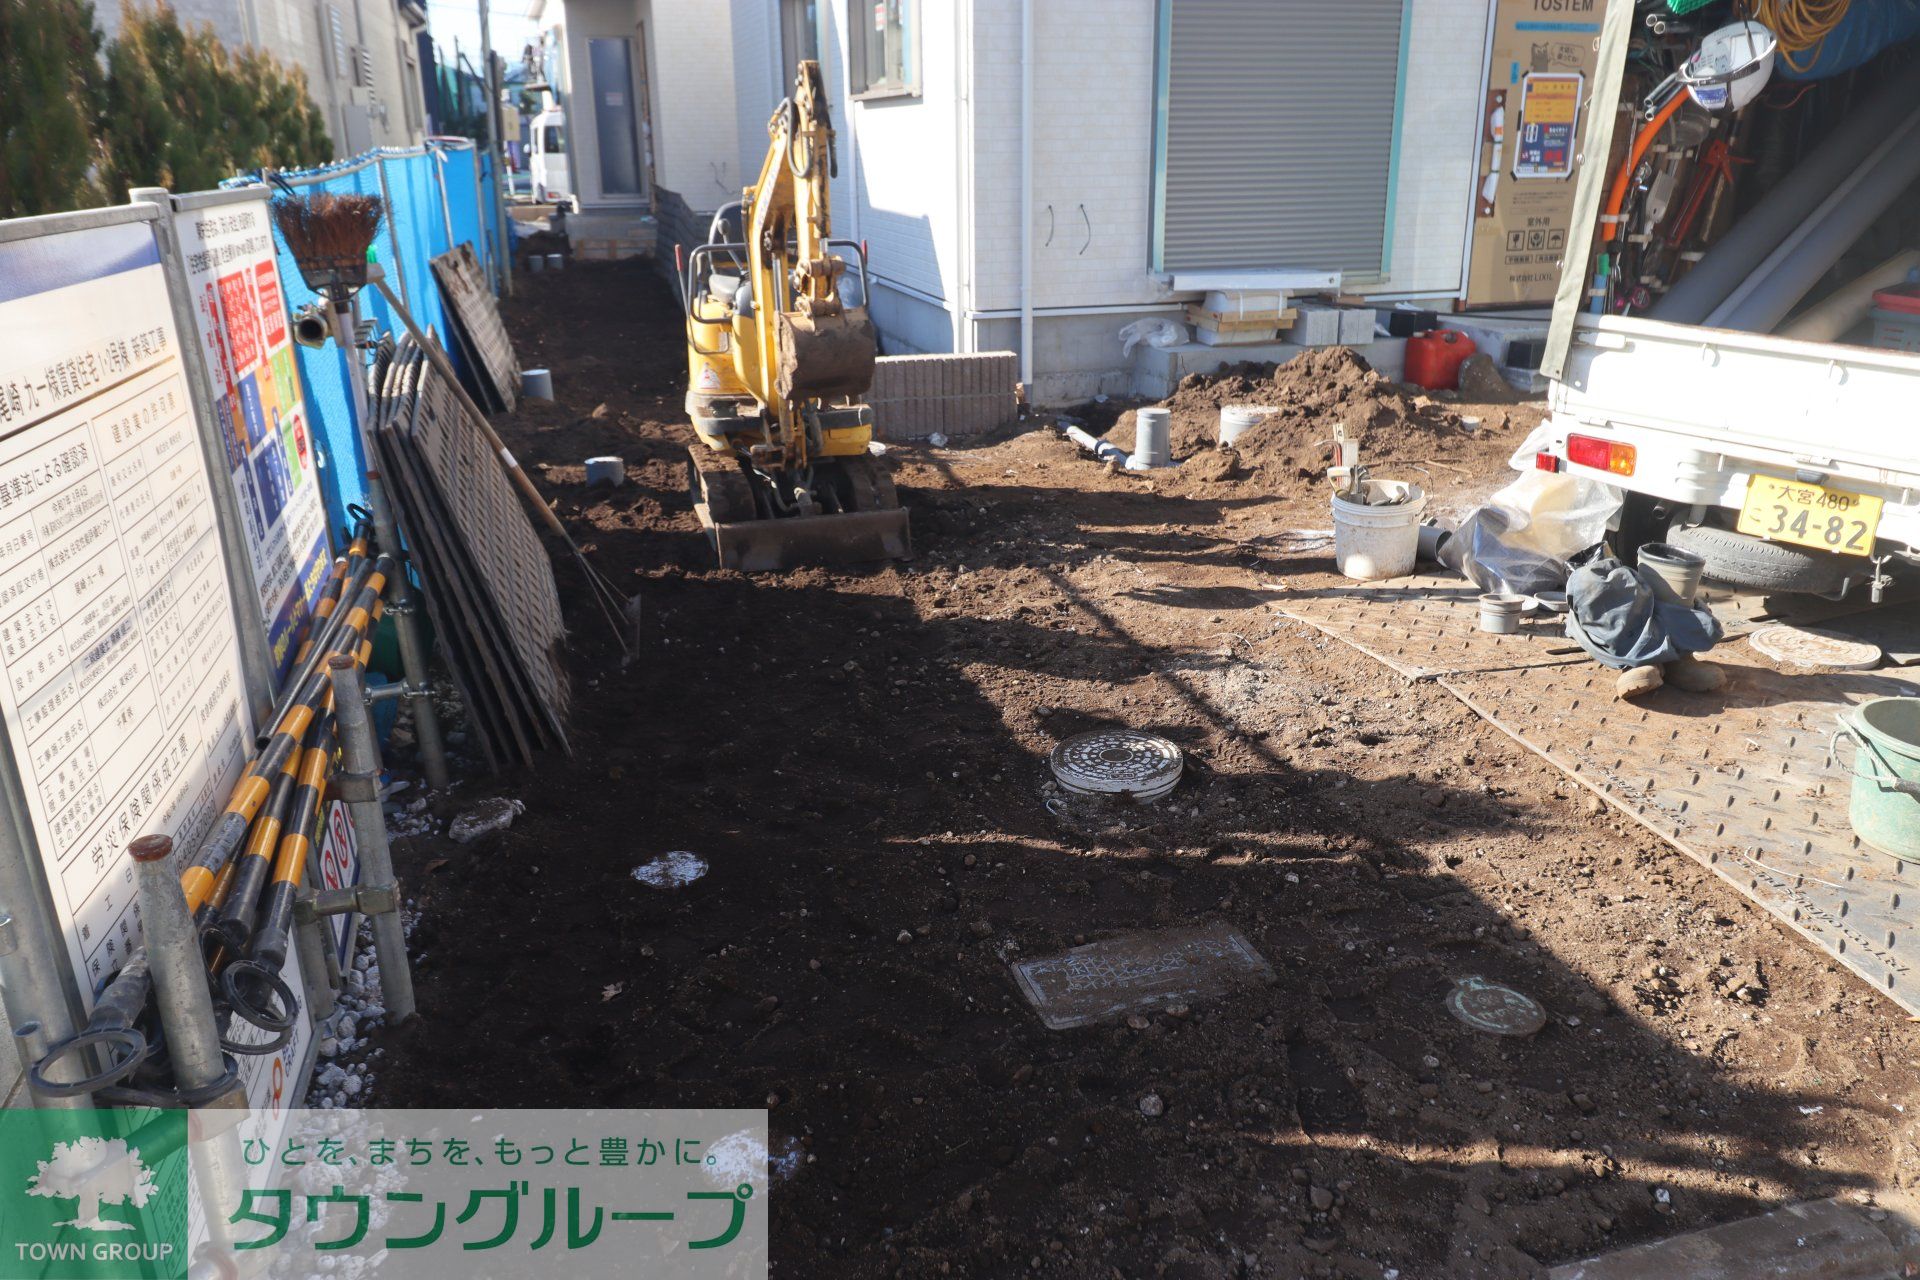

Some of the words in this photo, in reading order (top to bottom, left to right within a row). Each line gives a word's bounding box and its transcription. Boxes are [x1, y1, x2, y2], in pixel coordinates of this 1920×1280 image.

[1533, 0, 1594, 11] TOSTEM
[1776, 486, 1816, 505] 大宮
[1816, 493, 1850, 512] 480
[1749, 507, 1762, 523] こ
[1767, 504, 1868, 551] 34-82
[91, 733, 189, 874] 労災保険関係成立票
